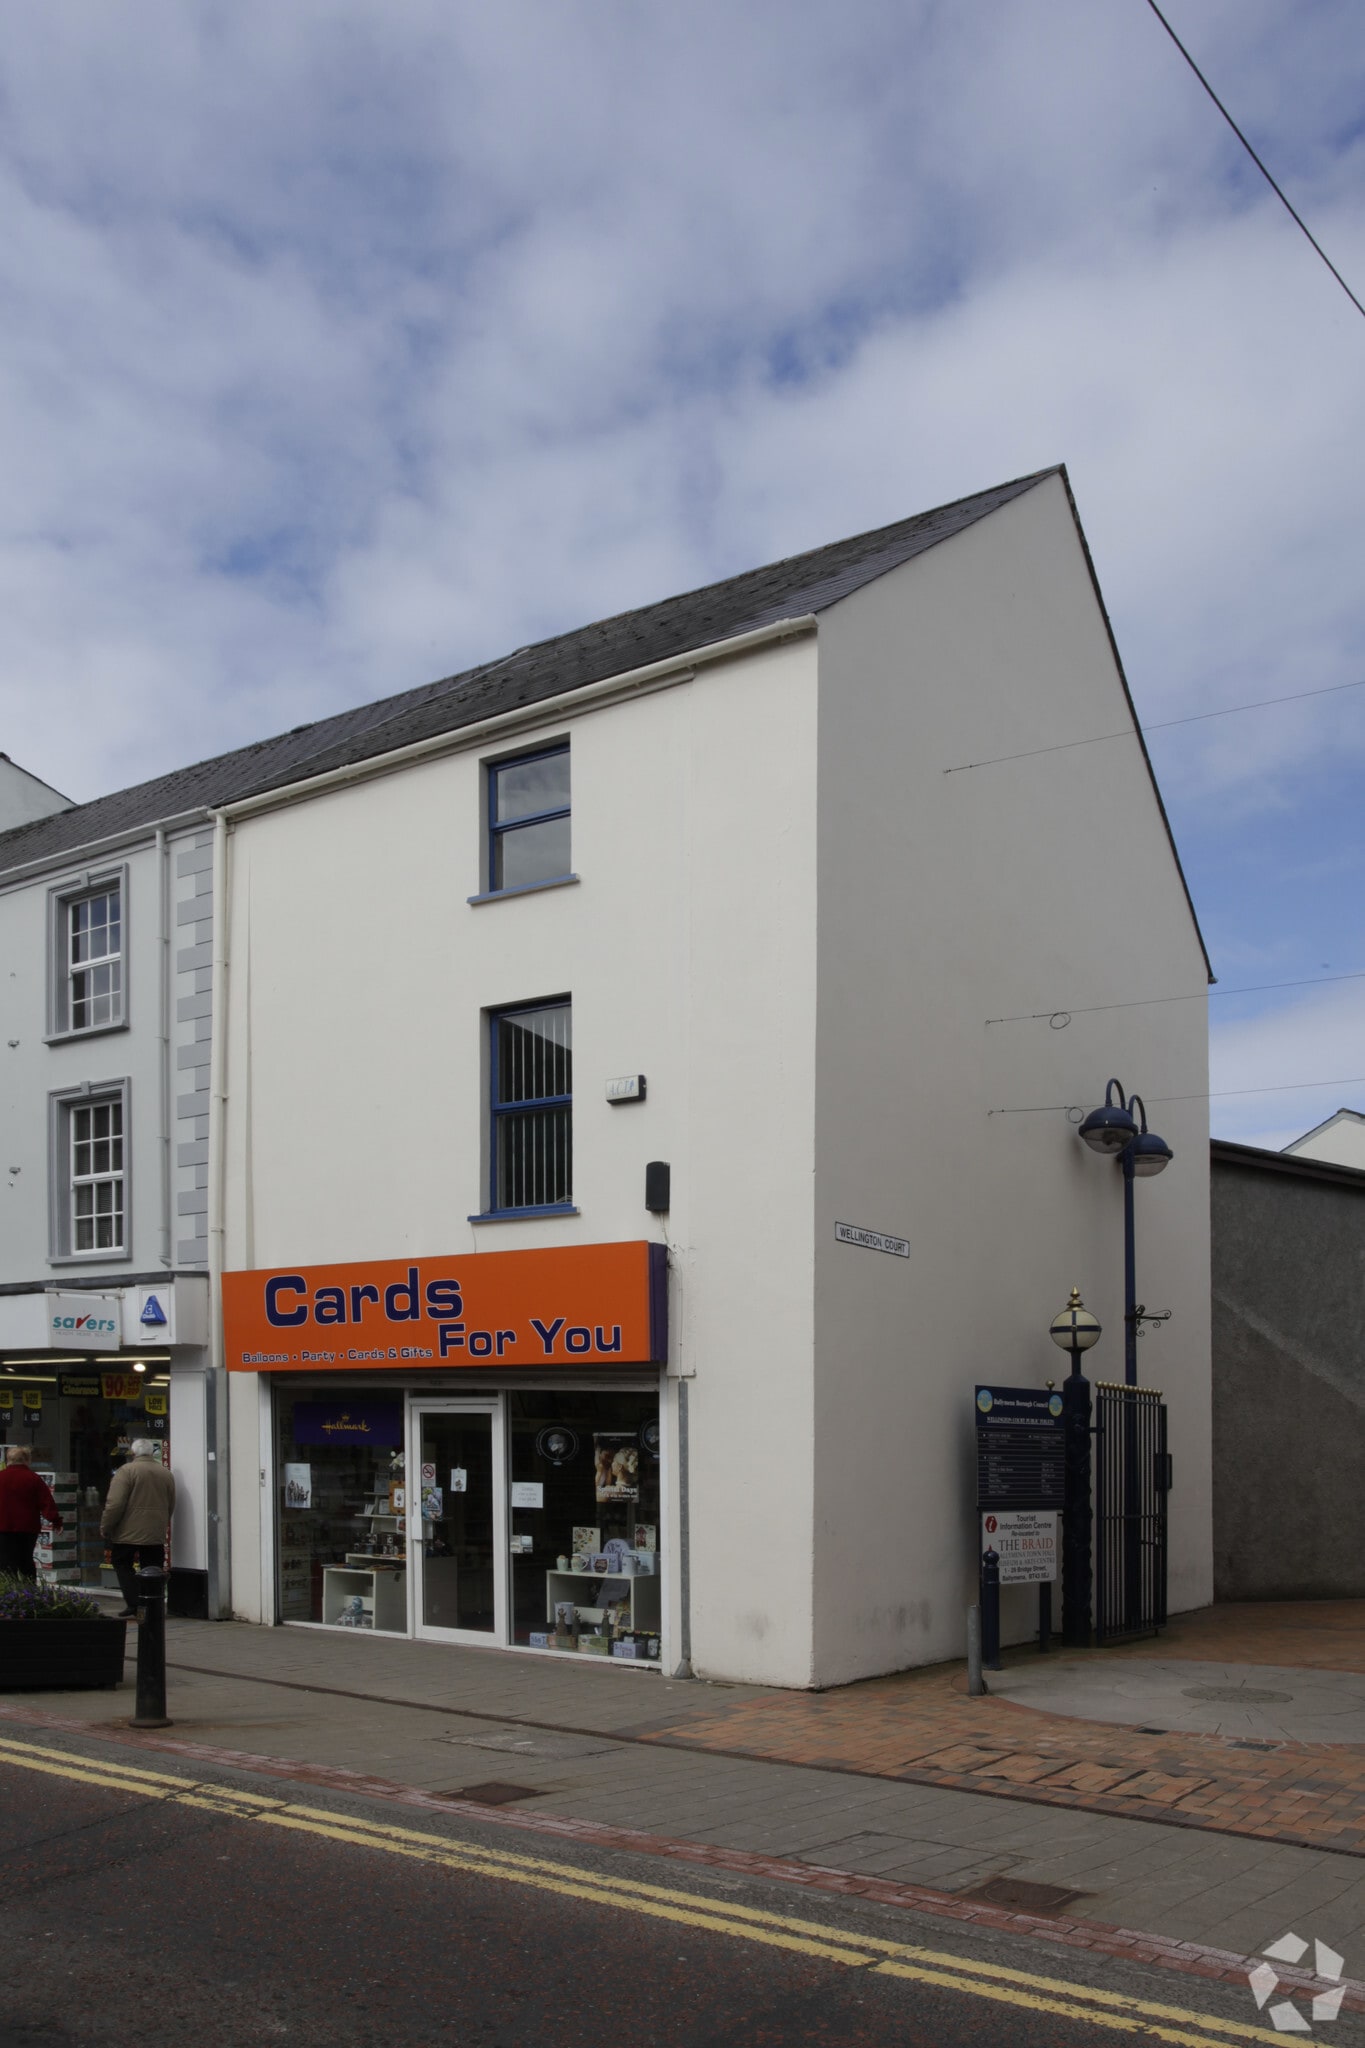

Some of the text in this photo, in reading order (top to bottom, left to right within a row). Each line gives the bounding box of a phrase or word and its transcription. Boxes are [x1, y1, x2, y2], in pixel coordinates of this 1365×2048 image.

[840, 1227, 906, 1253] WELLINGTON COURT
[265, 1266, 464, 1328] Cards
[53, 1314, 115, 1332] savers
[438, 1317, 622, 1358] For You
[242, 1347, 433, 1364] Balloons Party Cards & Gifts
[994, 1399, 1048, 1408] Ballymena Borough Council
[321, 1419, 371, 1435] Hallmark
[987, 1416, 1011, 1424] WELLINGTON
[998, 1538, 1053, 1551] THE BRAID
[1018, 1566, 1033, 1574] Bridge
[1033, 1565, 1047, 1573] Street,
